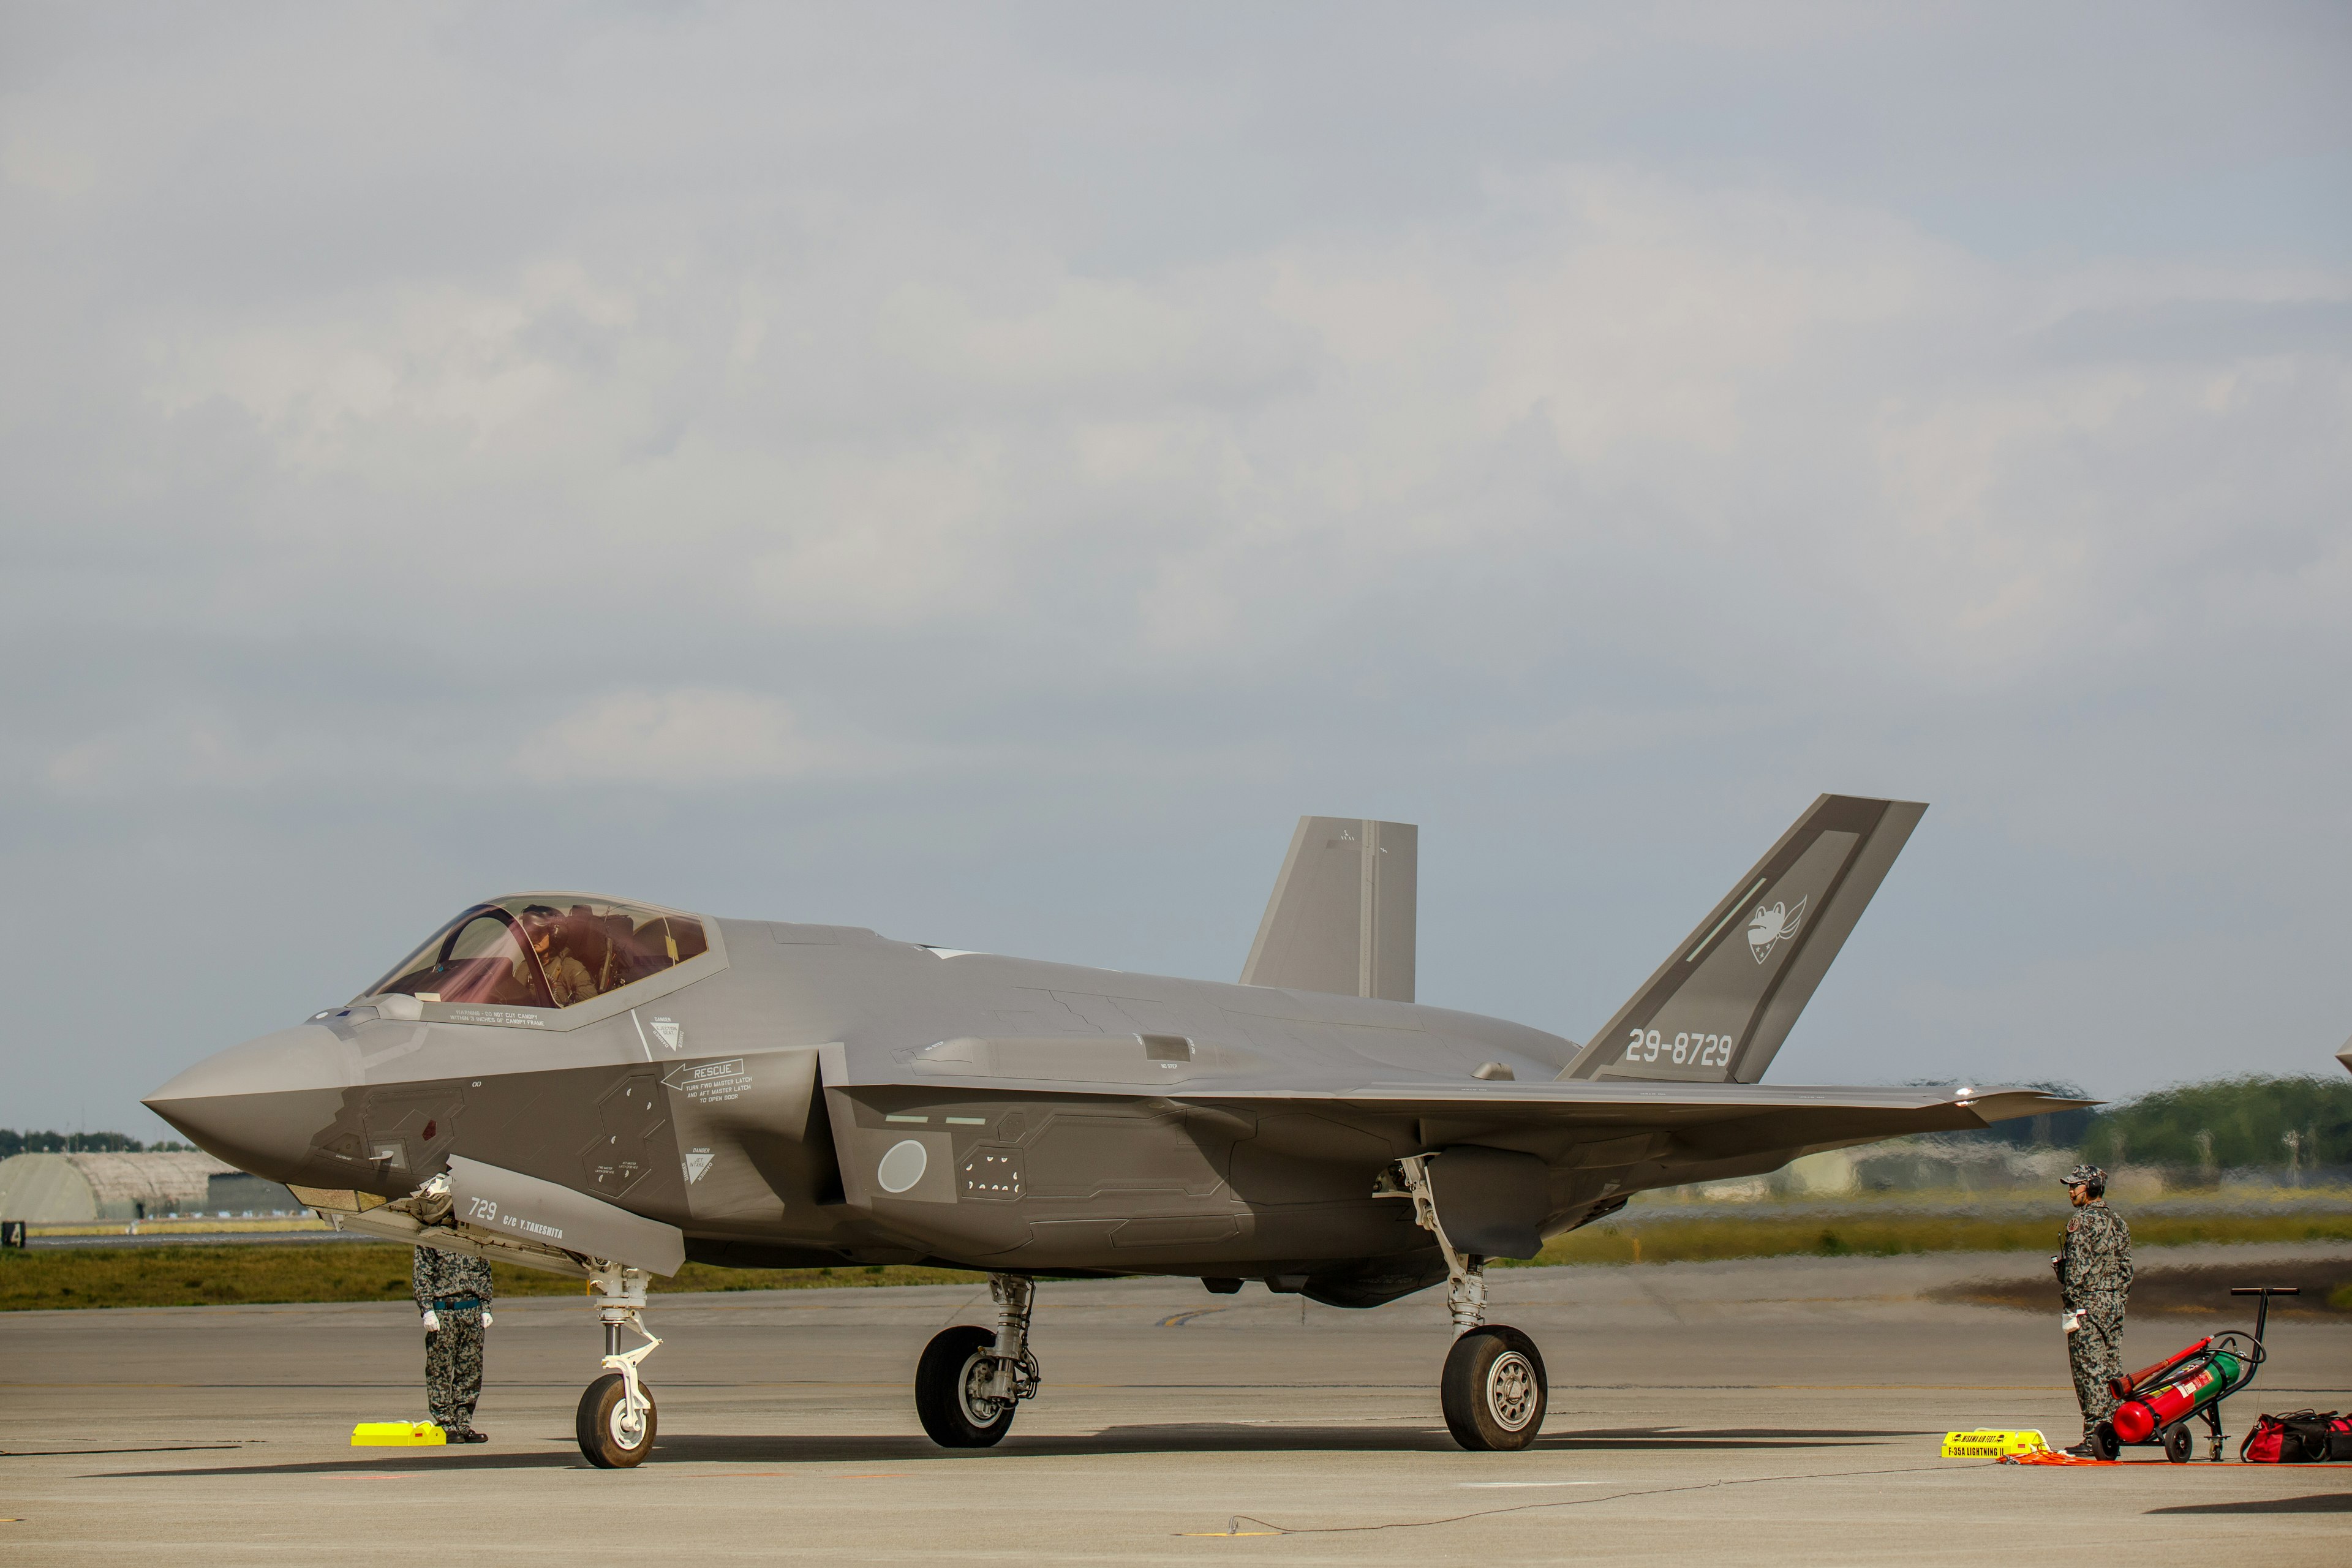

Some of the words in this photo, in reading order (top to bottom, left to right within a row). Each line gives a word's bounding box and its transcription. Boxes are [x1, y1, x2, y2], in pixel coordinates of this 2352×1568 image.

[653, 1030, 669, 1048] DANGER
[1626, 1028, 1732, 1066] 29-8729
[695, 1064, 731, 1078] RESCUE
[697, 1162, 713, 1181] DANGER
[469, 1197, 497, 1221] 729
[503, 1215, 517, 1227] C/C
[520, 1219, 563, 1239] Y.TAKESHITA
[10, 1223, 21, 1248] 4
[1948, 1447, 1965, 1455] F-35A
[1967, 1447, 1997, 1456] LIGHTNING
